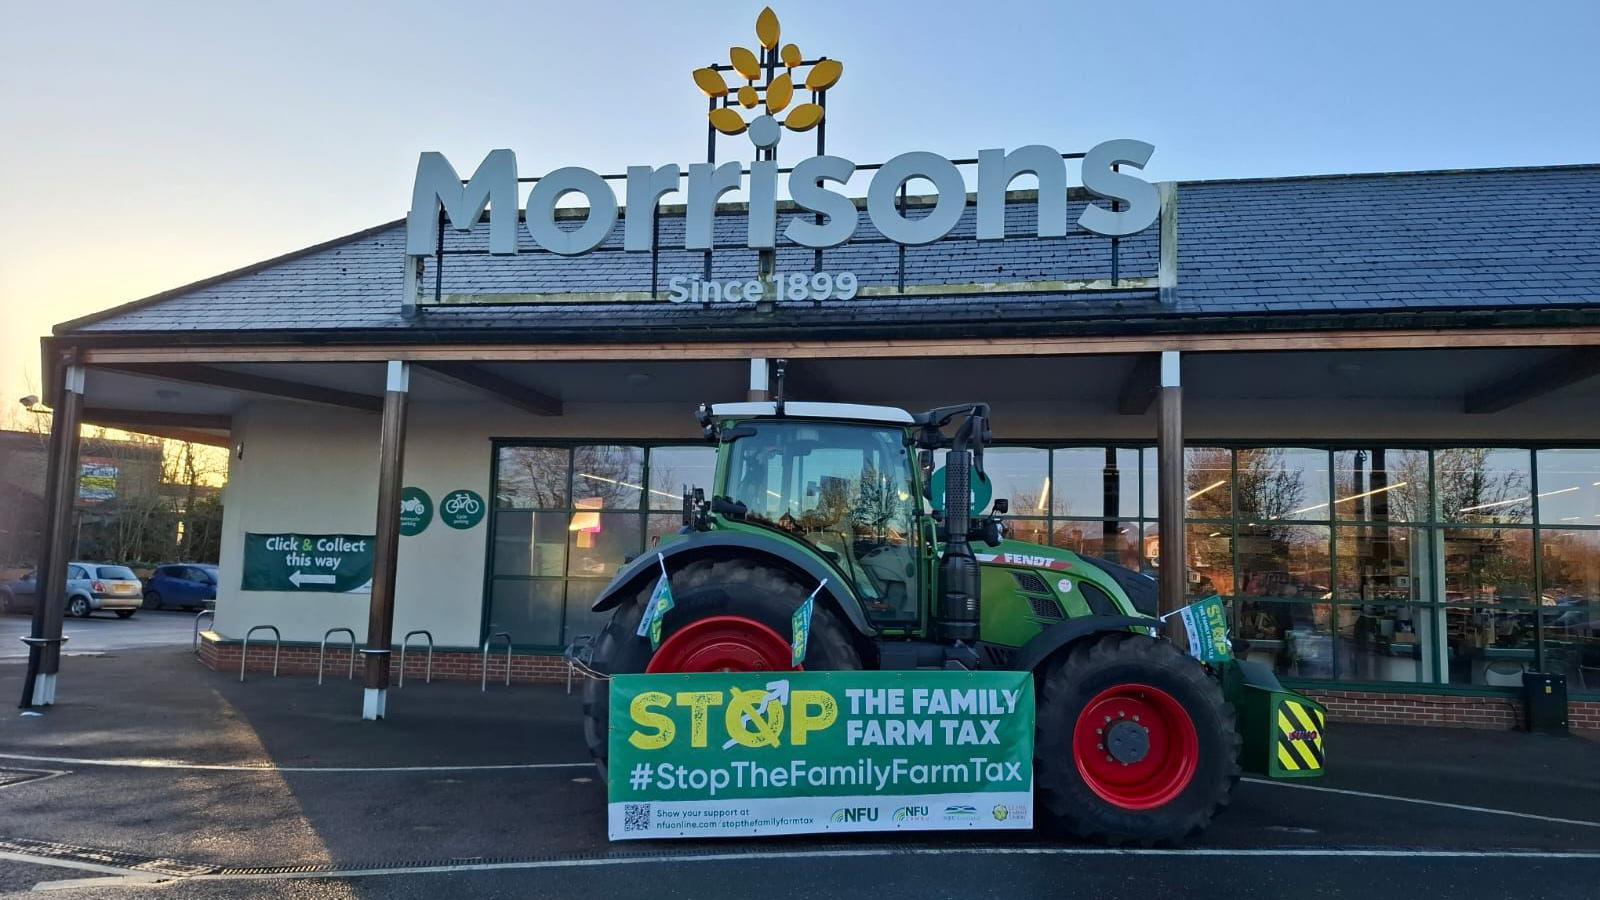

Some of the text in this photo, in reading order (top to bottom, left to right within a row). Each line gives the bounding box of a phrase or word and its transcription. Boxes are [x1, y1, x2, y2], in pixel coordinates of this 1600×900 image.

[407, 115, 1161, 257] Morrisons
[668, 272, 858, 303] Since 1899
[266, 537, 366, 552] Click & Collect
[286, 552, 341, 571] this way
[1004, 552, 1055, 568] FENDT
[845, 688, 1019, 715] THE FAMILY
[629, 686, 838, 750] STOP
[847, 719, 1001, 746] FARM TAX
[629, 757, 1023, 795] #StopTheFamilyFarmTax
[657, 809, 750, 819] Show your support at
[844, 807, 879, 823] NFU
[905, 806, 929, 817] NFU
